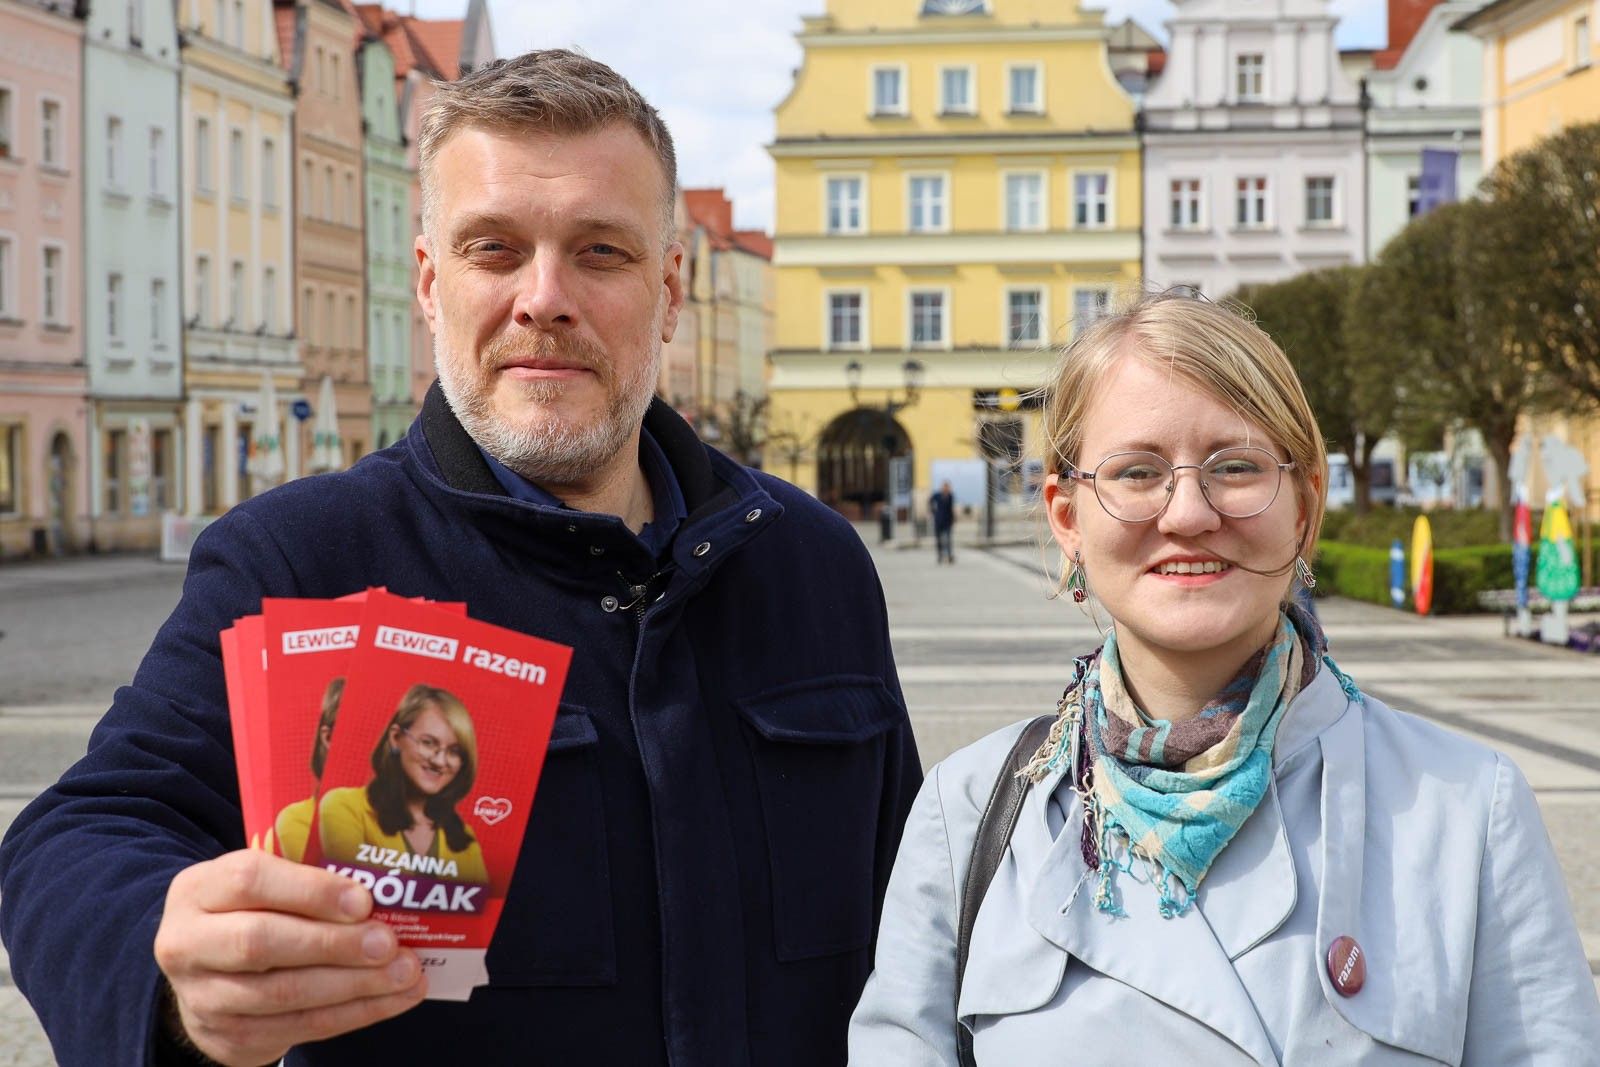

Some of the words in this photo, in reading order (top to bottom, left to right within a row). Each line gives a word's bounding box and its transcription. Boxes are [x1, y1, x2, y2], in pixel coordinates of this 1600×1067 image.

[287, 630, 357, 650] LEWICA
[381, 629, 452, 656] LEWICA
[463, 645, 547, 685] razem
[355, 843, 459, 877] ZUZANNA
[1337, 945, 1360, 986] razem
